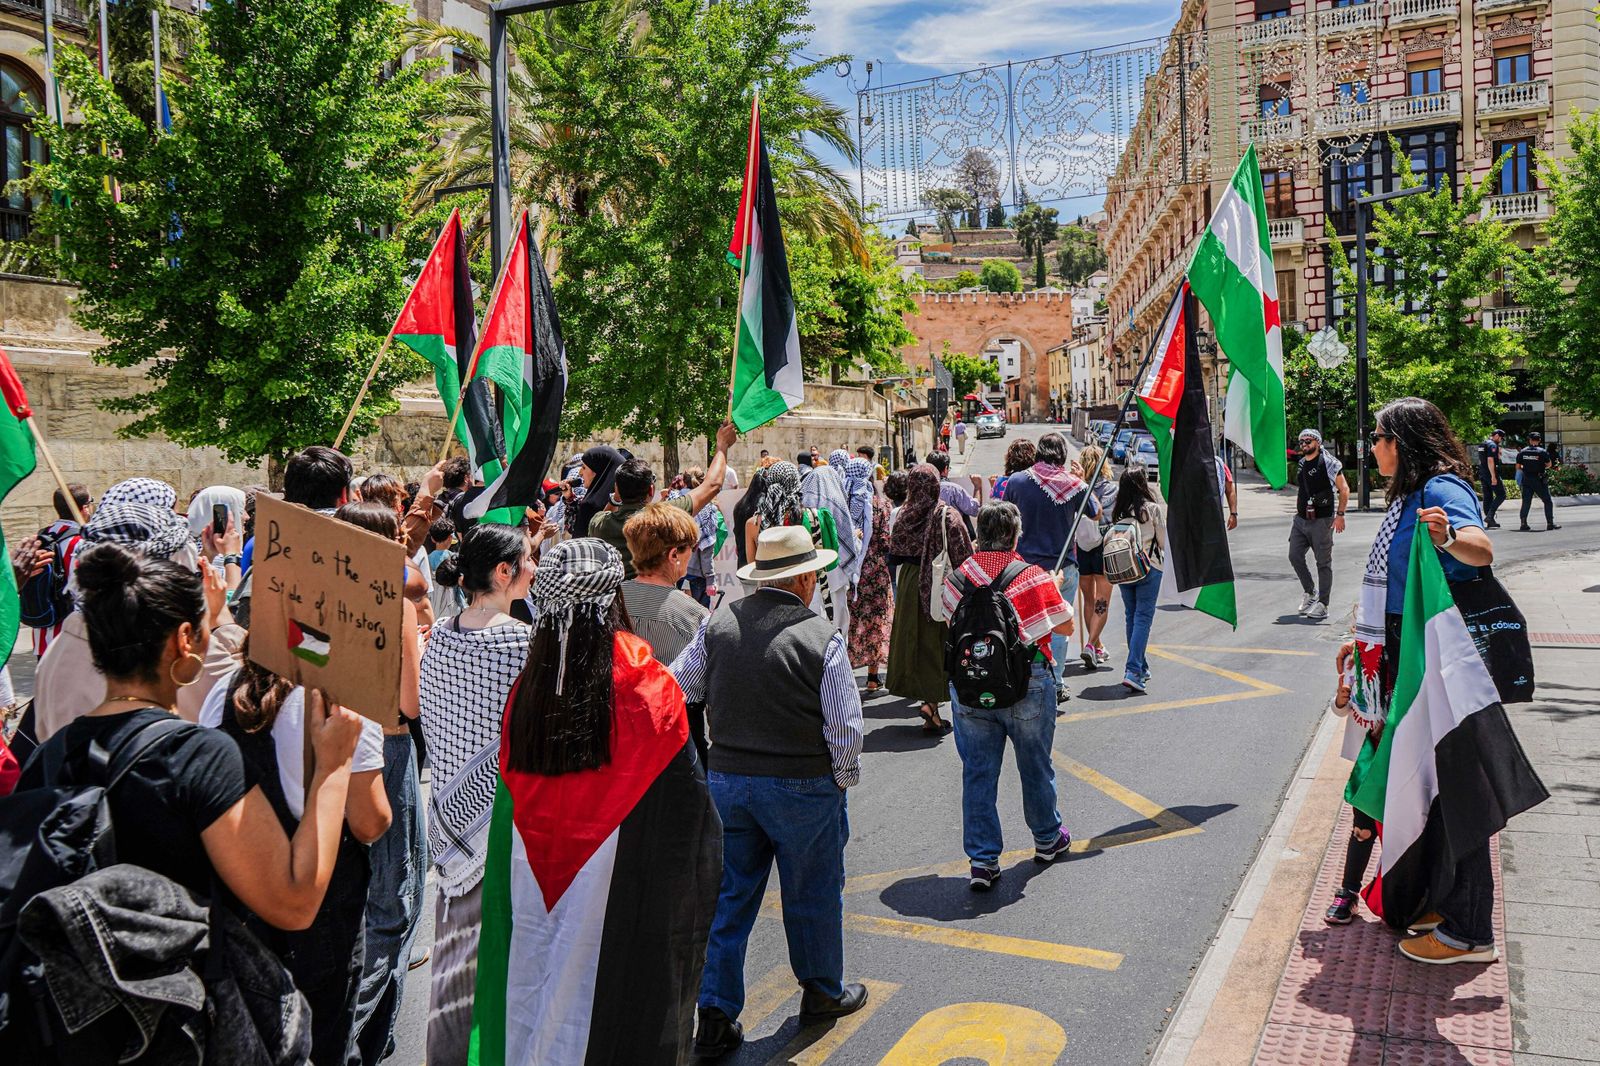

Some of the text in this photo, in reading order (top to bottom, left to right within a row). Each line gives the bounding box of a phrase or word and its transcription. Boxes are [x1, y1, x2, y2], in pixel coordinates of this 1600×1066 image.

[263, 520, 291, 561] Be
[333, 550, 359, 583] the
[369, 580, 397, 606] right
[268, 576, 387, 650] Side of History
[1491, 620, 1521, 630] CÓDIGO
